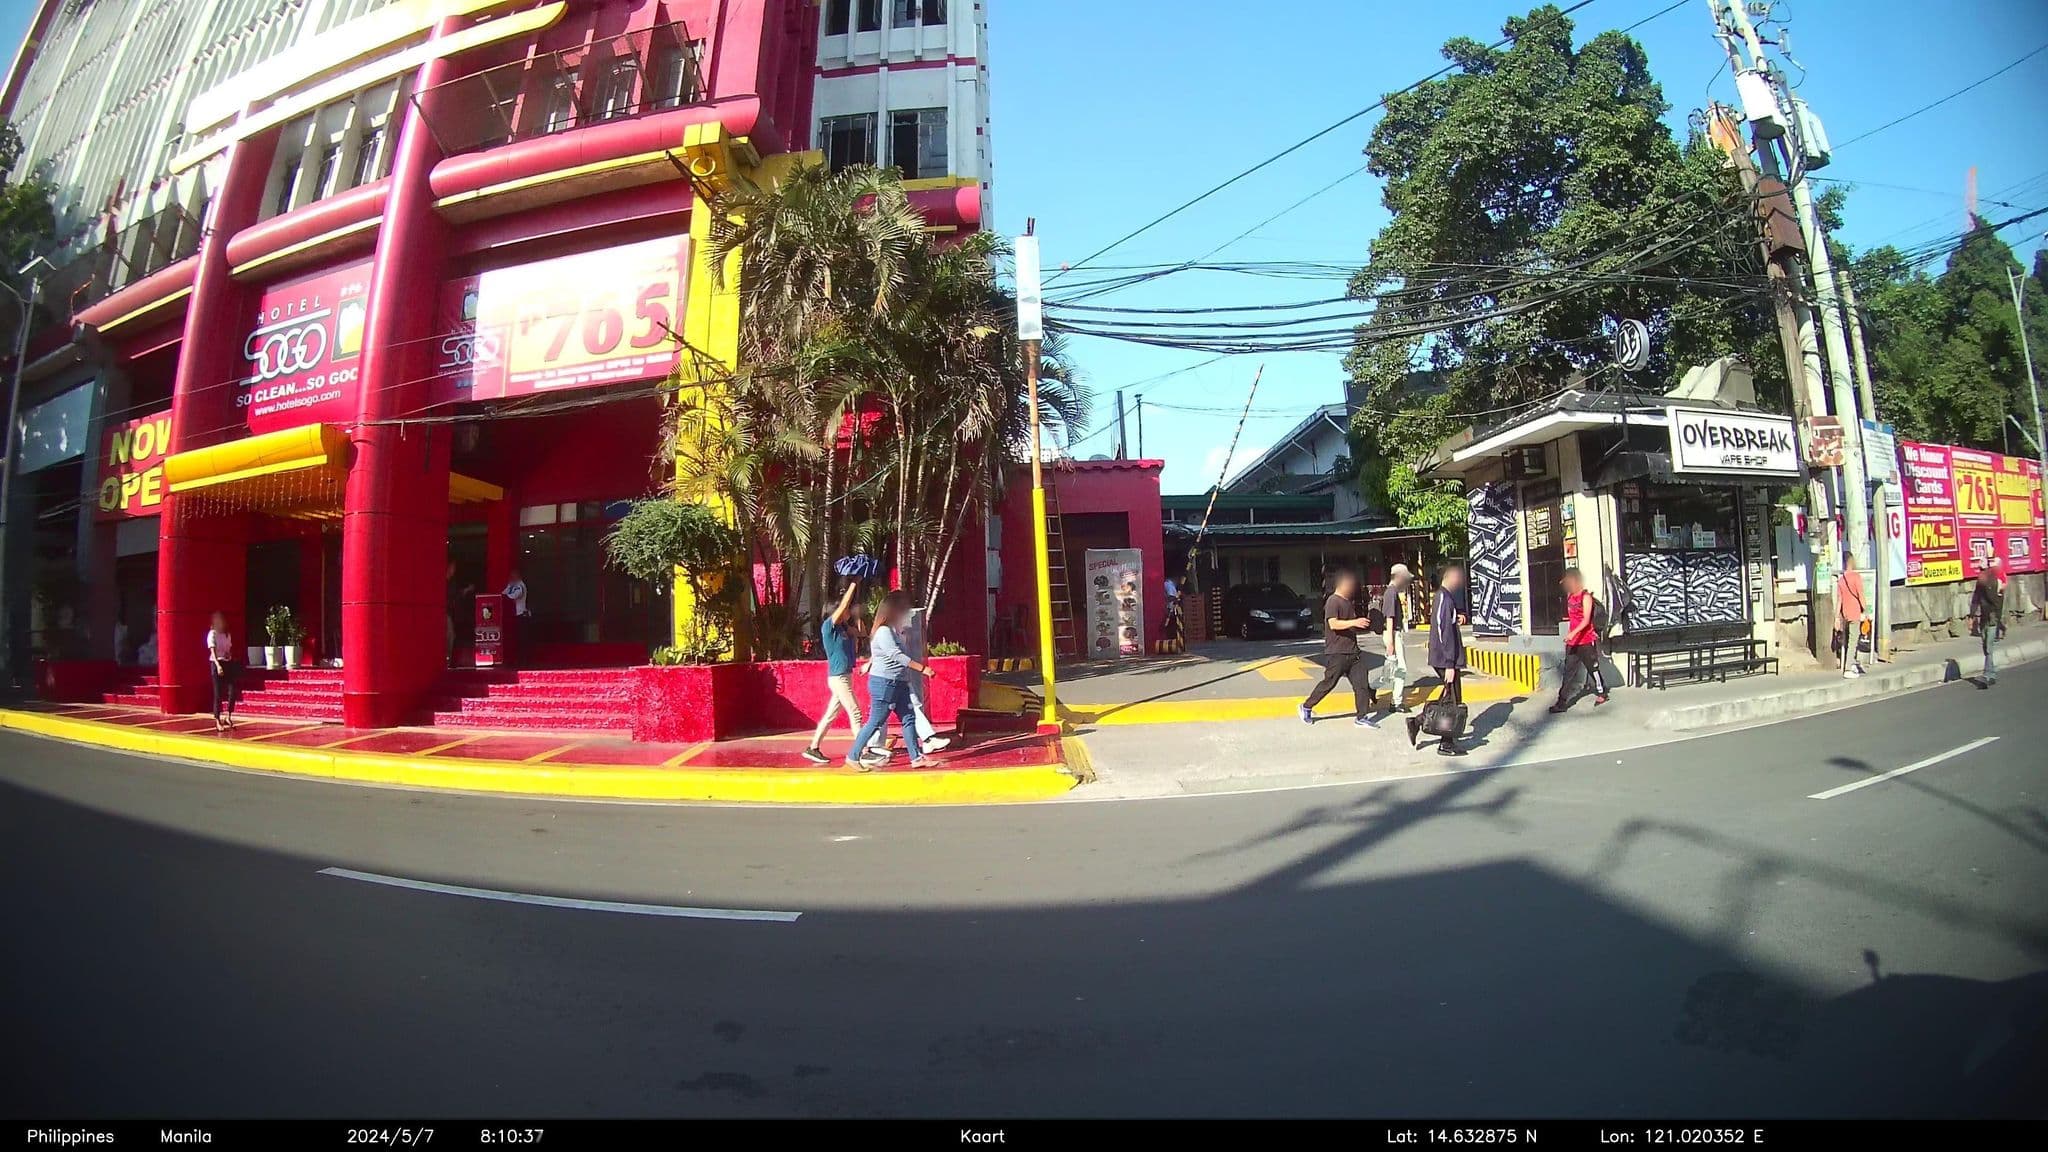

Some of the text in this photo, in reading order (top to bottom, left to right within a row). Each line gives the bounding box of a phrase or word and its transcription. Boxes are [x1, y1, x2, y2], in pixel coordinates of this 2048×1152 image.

[256, 295, 321, 325] HOTEL
[239, 308, 332, 386] SOGO
[236, 393, 252, 408] SO
[254, 390, 341, 416] www.hotelsogo.com
[1683, 419, 1792, 453] OVERBREAK
[1720, 454, 1768, 466] VAPE SHOP
[1903, 445, 1918, 461] We
[1904, 462, 1949, 479] Discount
[1915, 478, 1944, 494] Cards
[1912, 522, 1939, 549] 40%
[1924, 567, 1947, 578] Quezon
[1948, 564, 1961, 576] Ave.
